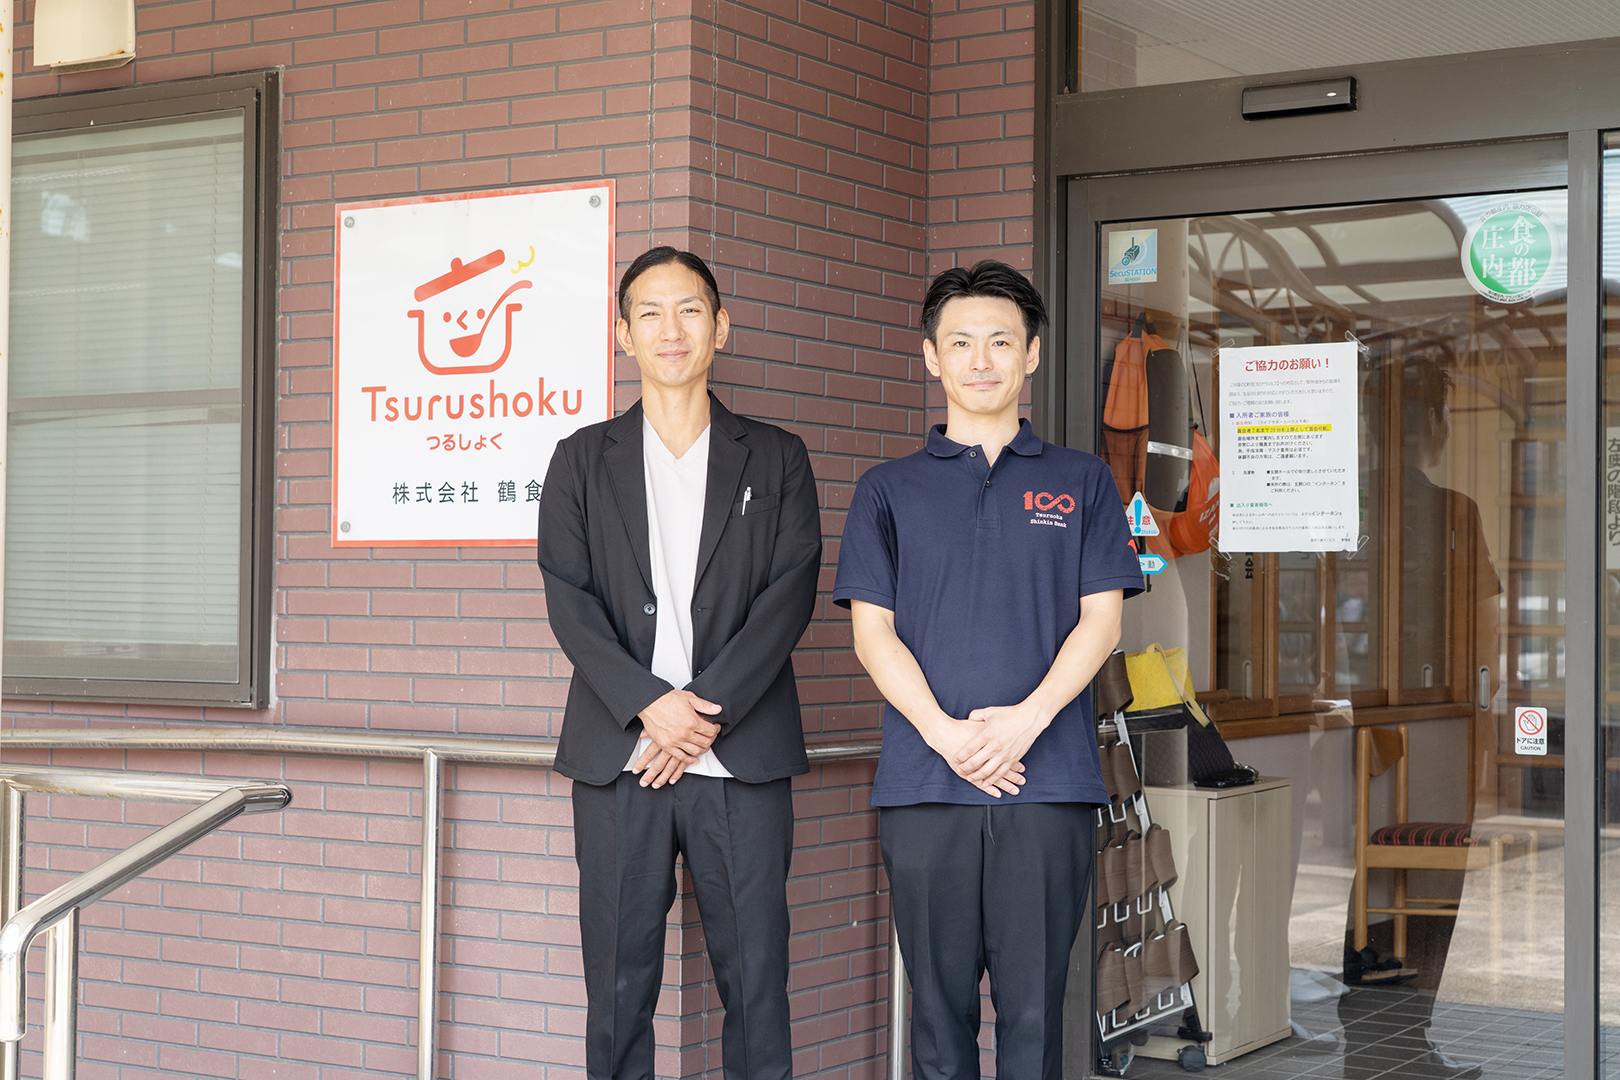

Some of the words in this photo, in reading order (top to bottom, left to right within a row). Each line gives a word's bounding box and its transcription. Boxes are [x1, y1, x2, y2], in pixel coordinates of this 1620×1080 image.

[1481, 225, 1505, 279] 庄内
[1507, 215, 1537, 286] 食の都
[1109, 267, 1157, 278] SecuSTATION
[1245, 357, 1329, 372] ご協力のお願い！
[361, 377, 583, 422] Tsurushoku
[1236, 410, 1290, 419] 入所者ご家族の皆様
[426, 432, 503, 452] つるしょく
[392, 481, 479, 505] 株式会社
[1030, 518, 1053, 526] Shinkin
[1053, 520, 1067, 528] Bank
[1035, 512, 1063, 520] Tsuruoka
[1517, 737, 1545, 745] ドアに注意
